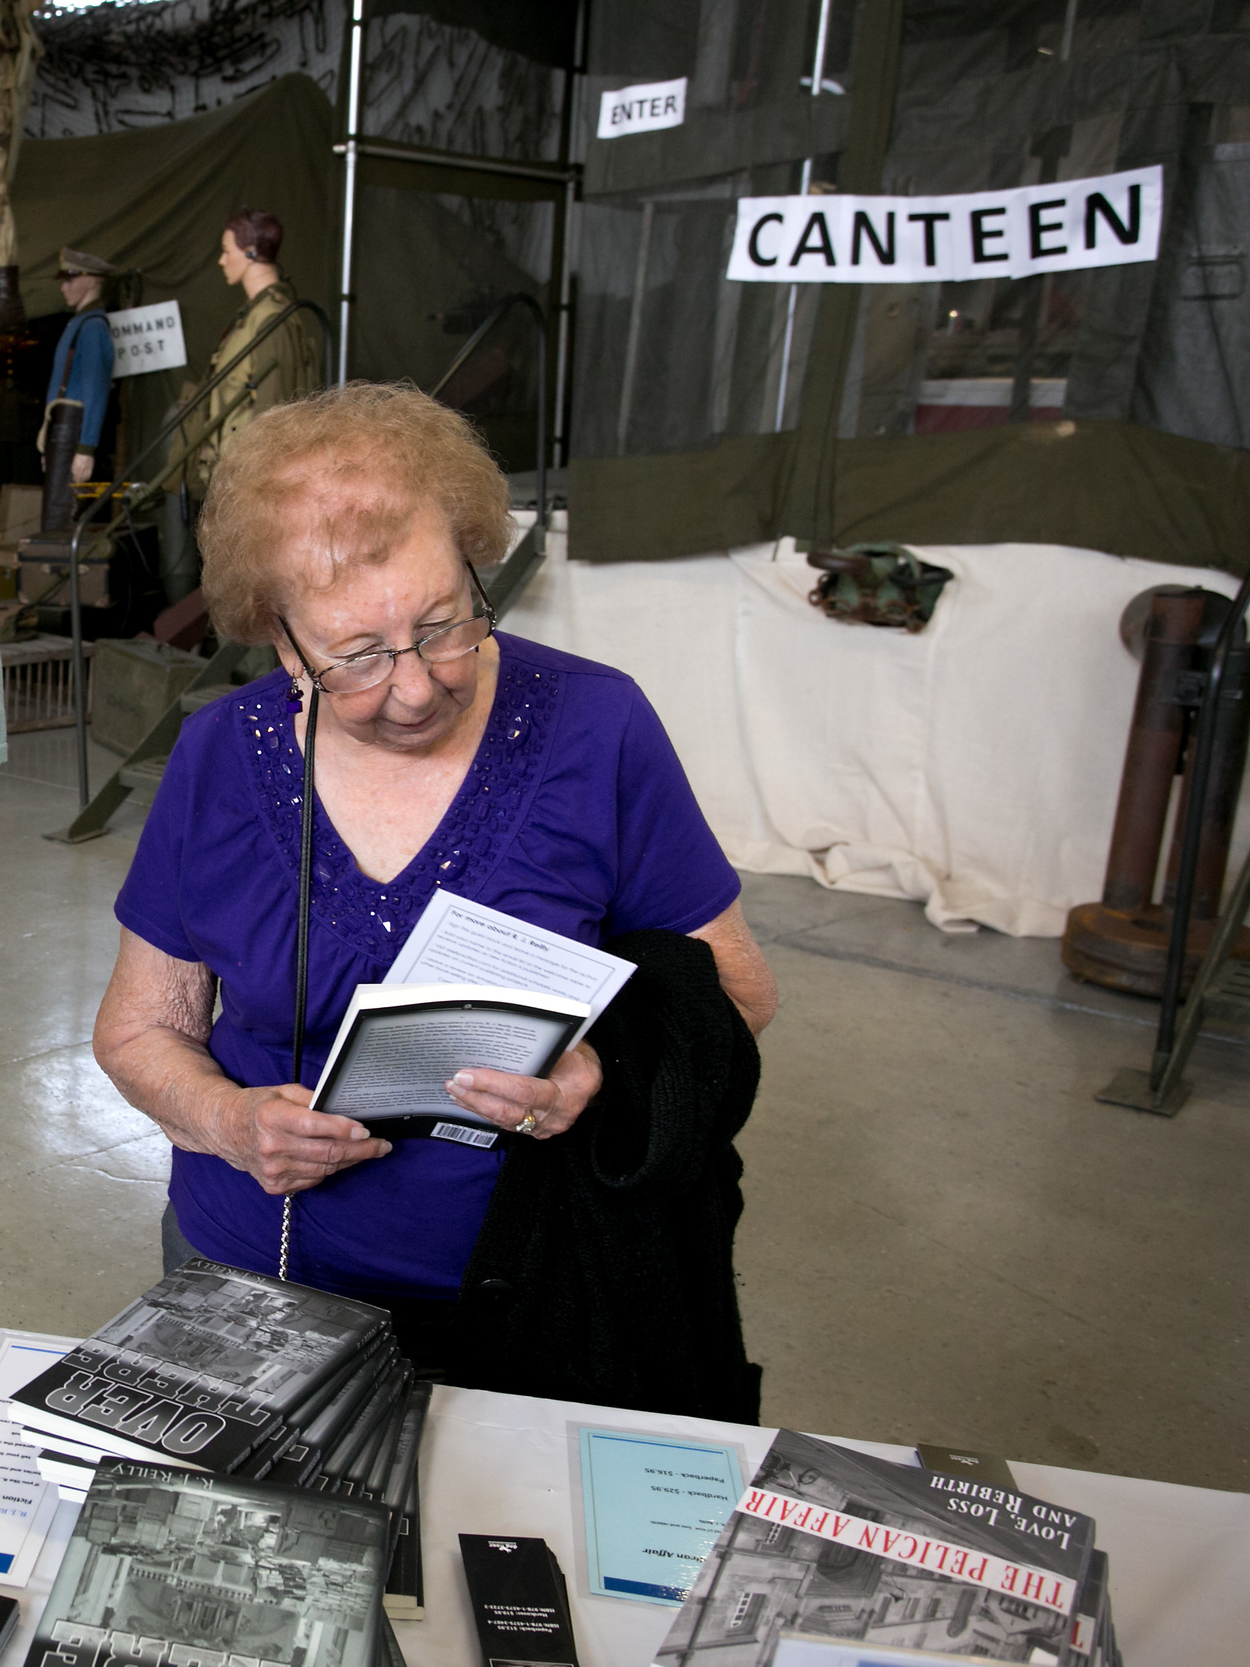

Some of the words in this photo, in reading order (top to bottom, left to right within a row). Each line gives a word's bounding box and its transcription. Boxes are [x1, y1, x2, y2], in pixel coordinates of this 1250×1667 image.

[609, 94, 679, 126] ENTER
[747, 183, 1144, 268] CANTEEN
[110, 316, 176, 339] OMMAND
[117, 339, 166, 360] POST
[190, 1260, 236, 1276] REILLY
[60, 1338, 275, 1426] THERE
[45, 1370, 226, 1454] OVER
[110, 1462, 170, 1484] REILLY
[176, 1472, 192, 1487] J.
[644, 1468, 673, 1477] $16.95
[681, 1472, 725, 1483] Paperback
[196, 1476, 214, 1492] R.
[651, 1485, 680, 1494] $29.95
[930, 1474, 1022, 1514] REBIRTH
[2, 1494, 32, 1505] Fiction
[688, 1490, 728, 1501] Hardback
[10, 1508, 16, 1516] J.
[18, 1510, 27, 1518] R.
[744, 1490, 850, 1537] AFFAIR
[946, 1497, 999, 1526] LOSS
[1032, 1504, 1076, 1527] AND
[1009, 1514, 1070, 1550] LOVE,
[642, 1548, 674, 1558] Affair
[858, 1524, 989, 1582] PELICAN
[1000, 1566, 1064, 1609] THE
